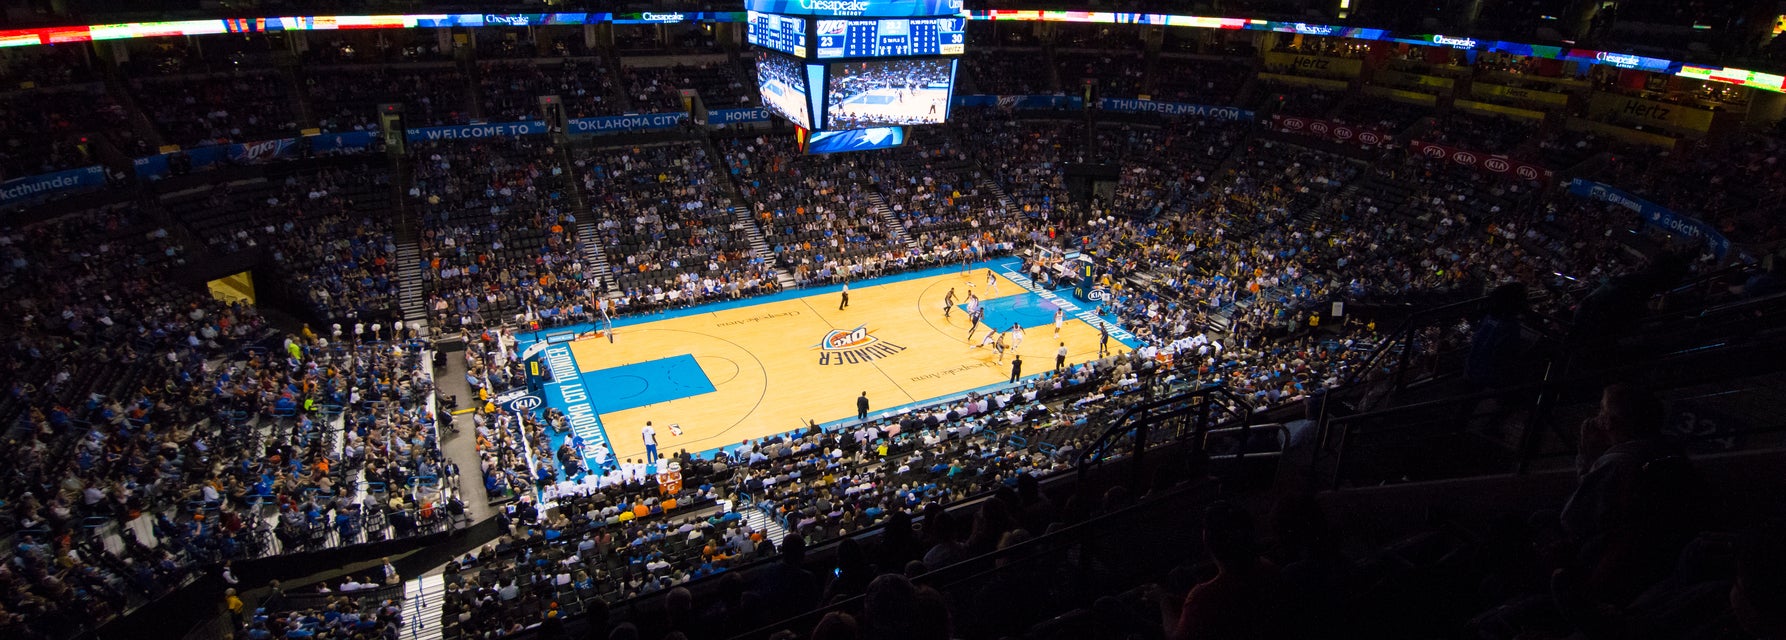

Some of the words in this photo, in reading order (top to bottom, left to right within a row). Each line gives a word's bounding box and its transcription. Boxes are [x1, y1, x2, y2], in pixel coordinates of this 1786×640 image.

[800, 0, 867, 15] Chesapeake
[642, 11, 684, 23] Chesapeake
[820, 36, 833, 47] 23
[951, 34, 963, 44] 30
[1433, 34, 1476, 48] Chesapeake
[1293, 55, 1330, 70] Hertz
[1596, 51, 1639, 66] Chesapeake
[726, 110, 758, 121] HOME
[1112, 99, 1240, 121] THUNDER.NBACOM
[1623, 100, 1670, 120] Hertz
[578, 117, 650, 130] OKLAHOMA
[653, 114, 681, 127] CITY
[427, 125, 504, 140] WELCOME
[509, 124, 529, 135] TO
[1050, 298, 1082, 312] CITY
[1074, 310, 1136, 341] THUNDER
[833, 328, 867, 348] OKC
[819, 340, 908, 366] THUNDER
[548, 346, 580, 384] THUNDER
[559, 383, 588, 404] CITY
[515, 398, 537, 410] KIA
[567, 402, 606, 459] OKLAHOMA
